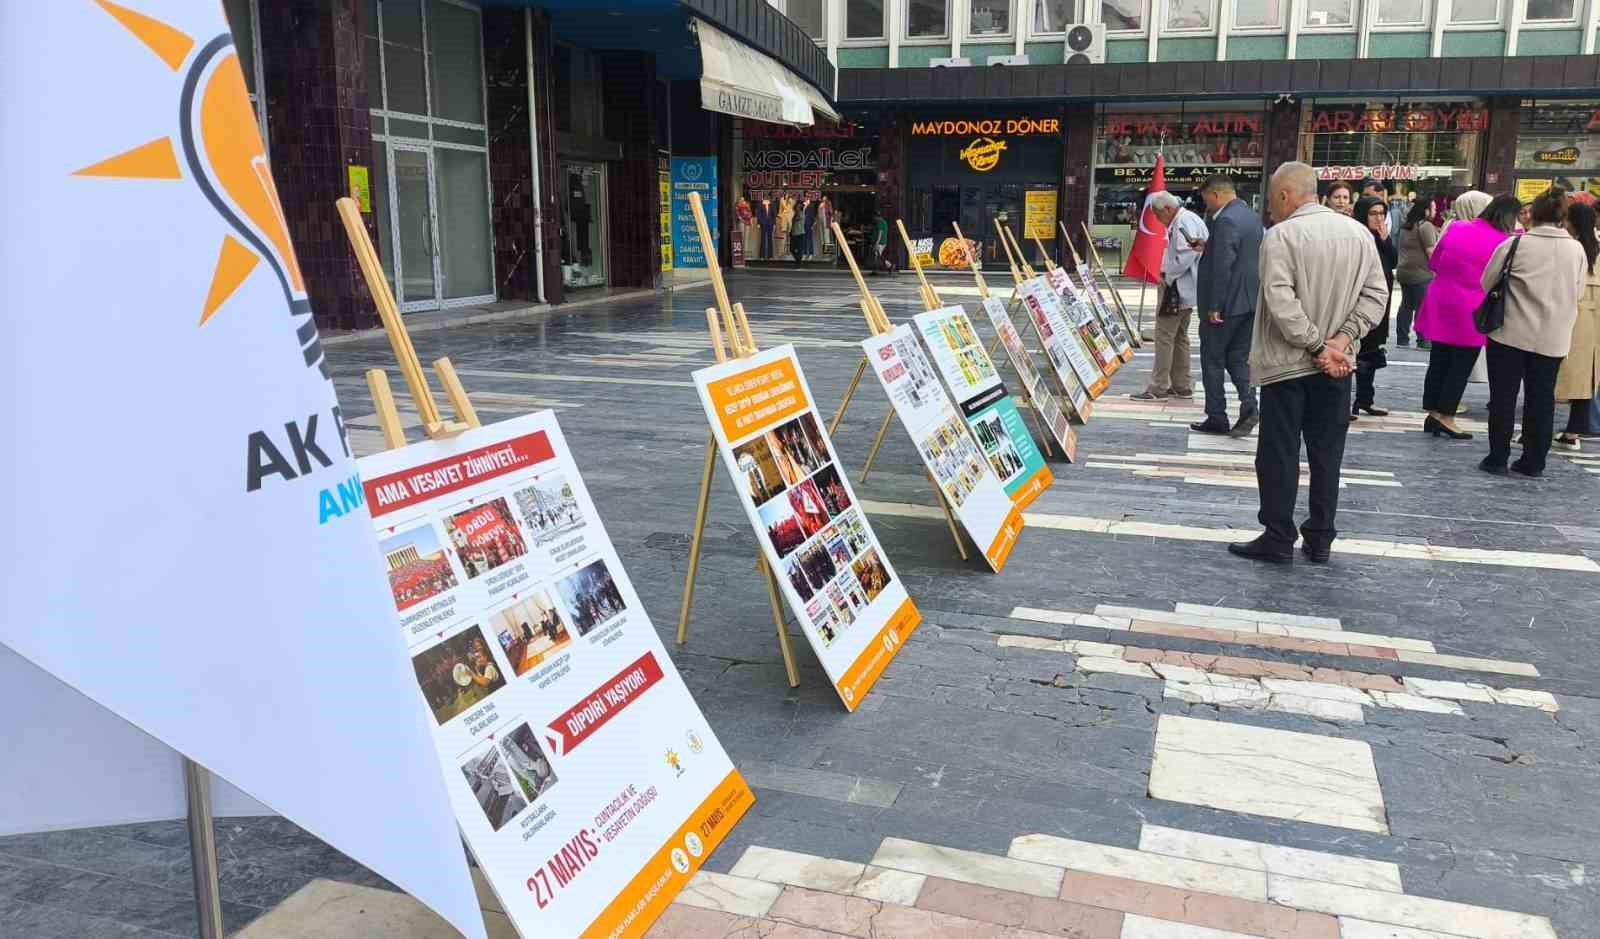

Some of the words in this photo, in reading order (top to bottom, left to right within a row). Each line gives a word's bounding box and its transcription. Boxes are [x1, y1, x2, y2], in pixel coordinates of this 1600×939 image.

[912, 120, 1002, 135] MAYDONOZ
[1007, 117, 1059, 134] DÖNER
[747, 170, 825, 188] OUTLET
[1190, 167, 1243, 175] ALTIN
[1320, 165, 1365, 179] ARAS
[247, 414, 334, 492] AK
[375, 481, 411, 507] AMA
[408, 463, 464, 495] VESAYET
[465, 510, 495, 535] ORDU
[566, 693, 608, 737] DİPDİRİ
[604, 667, 647, 705] YAŞIYOR!
[527, 867, 554, 910] 27
